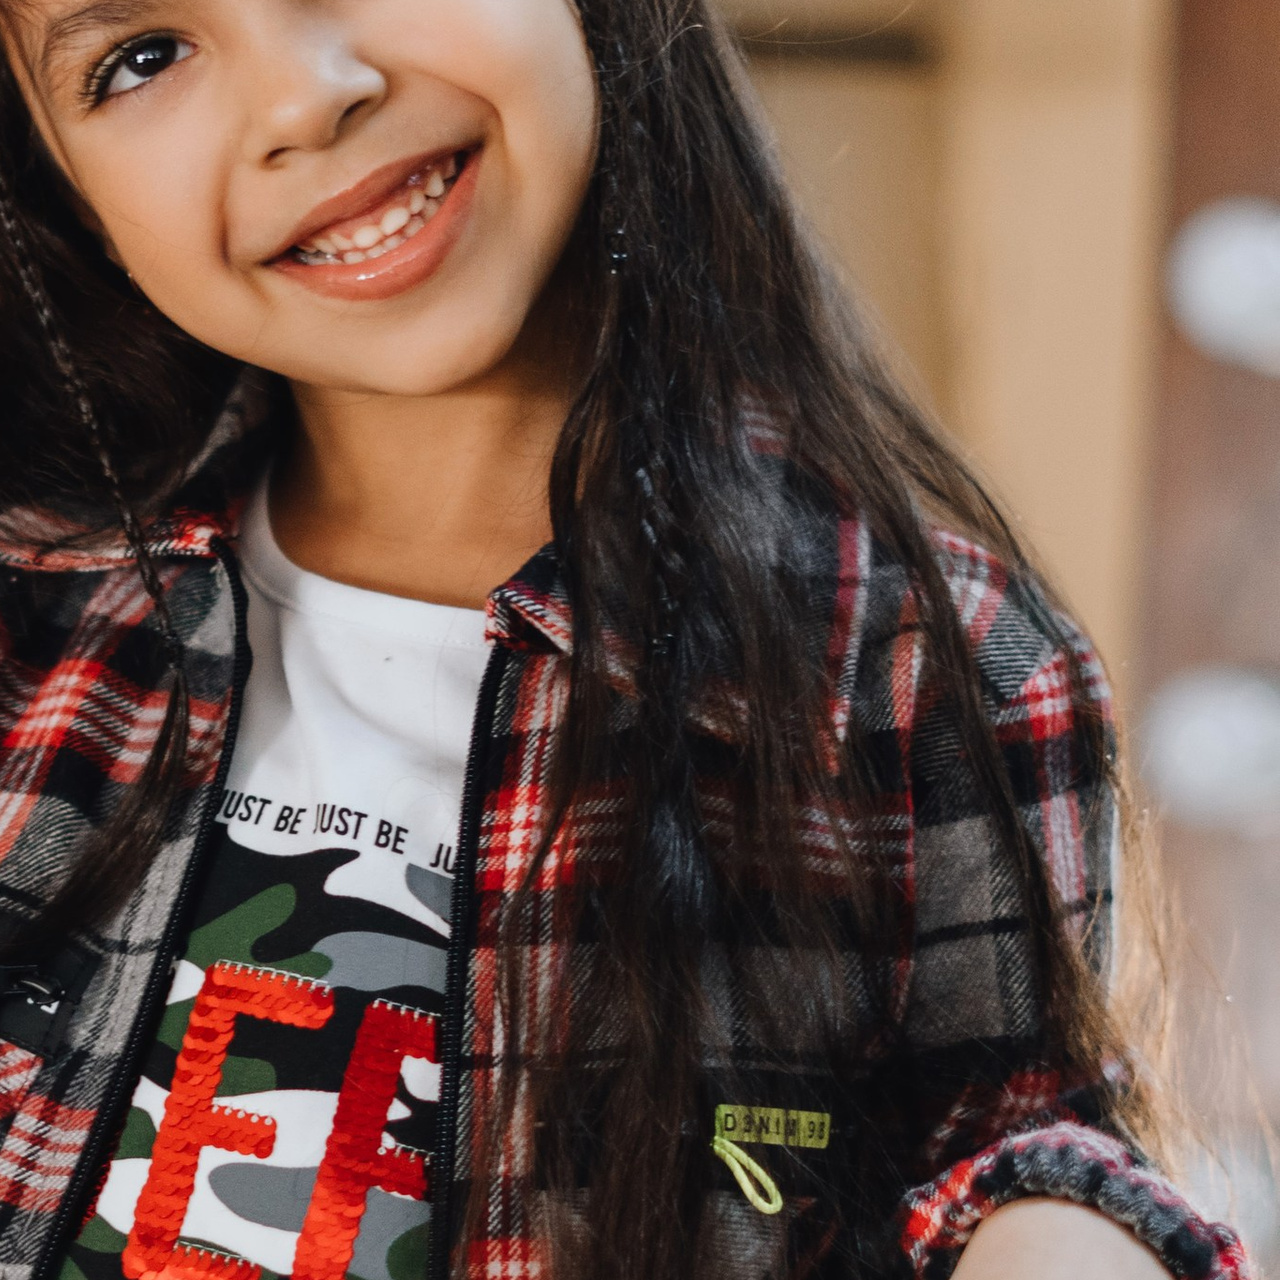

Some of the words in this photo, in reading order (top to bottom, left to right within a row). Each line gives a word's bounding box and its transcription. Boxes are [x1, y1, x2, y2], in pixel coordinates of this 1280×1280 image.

[274, 806, 307, 835] BE
[313, 804, 368, 840] JUST
[374, 819, 410, 855] BE
